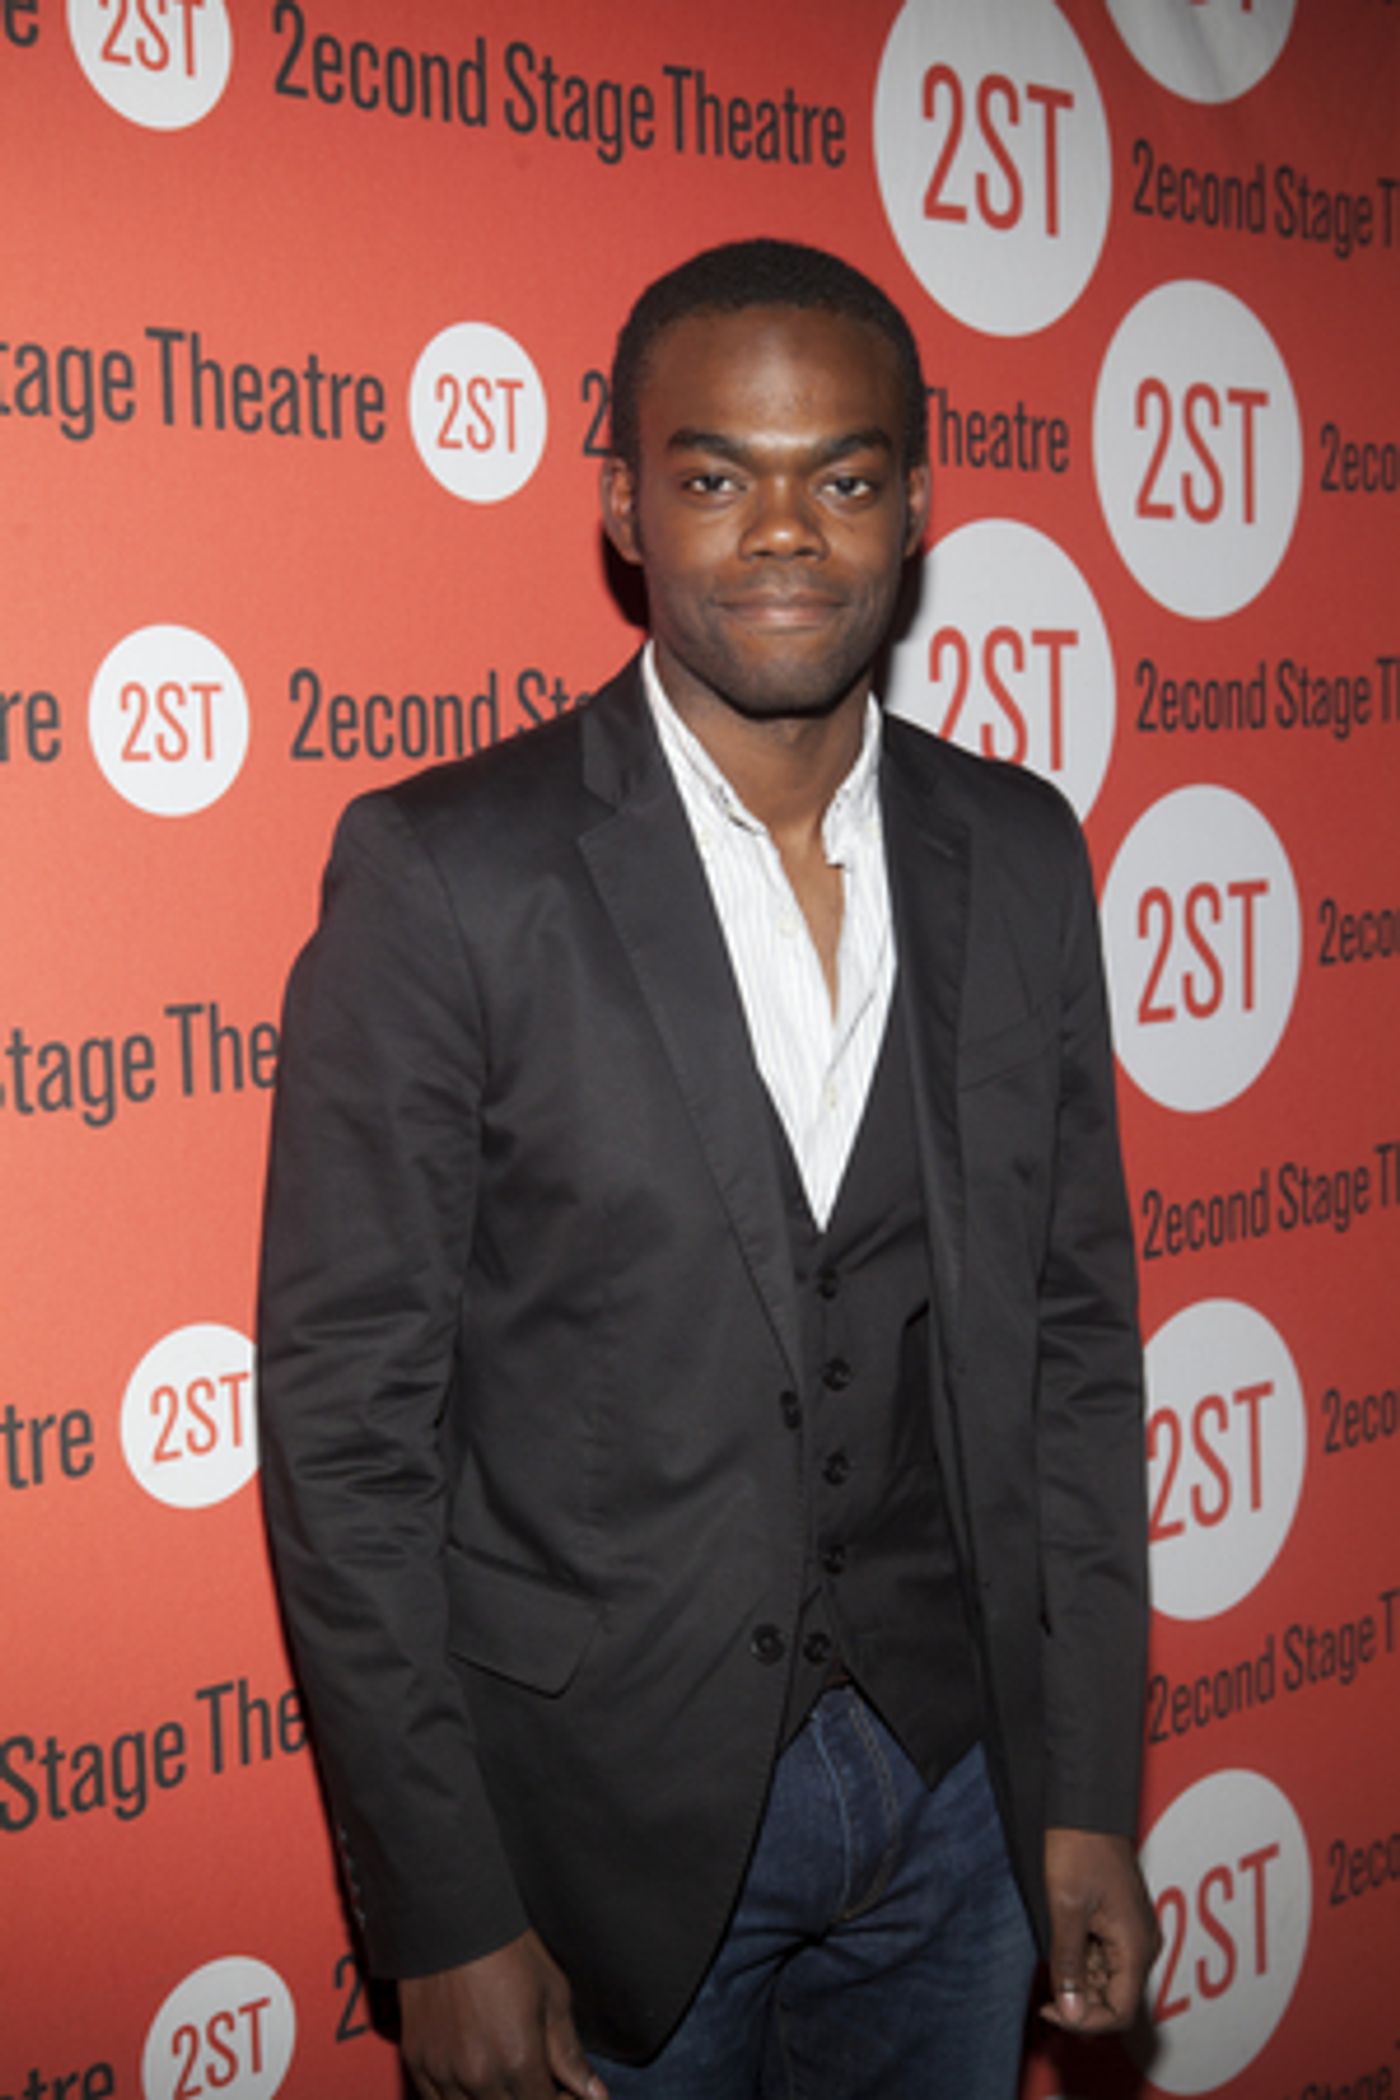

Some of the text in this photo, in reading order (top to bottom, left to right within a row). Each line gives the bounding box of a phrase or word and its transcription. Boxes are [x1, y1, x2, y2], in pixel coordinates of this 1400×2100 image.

[101, 0, 202, 78] 2ST
[272, 0, 846, 168] 2econd Stage Theatre
[921, 62, 1075, 238] 2ST
[1132, 138, 1266, 234] 2econd
[1274, 165, 1373, 261] Stage
[145, 326, 386, 442] Theatre
[436, 374, 524, 454] 2ST
[1135, 377, 1269, 525] 2ST
[120, 681, 223, 762] 2ST
[289, 667, 498, 760] 2econd
[928, 626, 1078, 771] 2ST
[1136, 657, 1267, 732] 2econd
[1275, 659, 1371, 741] Stage
[1137, 879, 1269, 1024] 2ST
[0, 1028, 156, 1129] tage
[1143, 1168, 1271, 1261] 2econd
[1277, 1162, 1371, 1234] Stage
[0, 1404, 95, 1491] tre
[149, 1371, 249, 1465] 2ST
[1146, 1380, 1275, 1545] 2ST
[1149, 1635, 1275, 1743] 2econd
[1282, 1614, 1376, 1690] Stage
[0, 1721, 187, 1833] Stage
[1154, 1842, 1281, 2023] 2ST
[171, 1997, 272, 2100] 2ST
